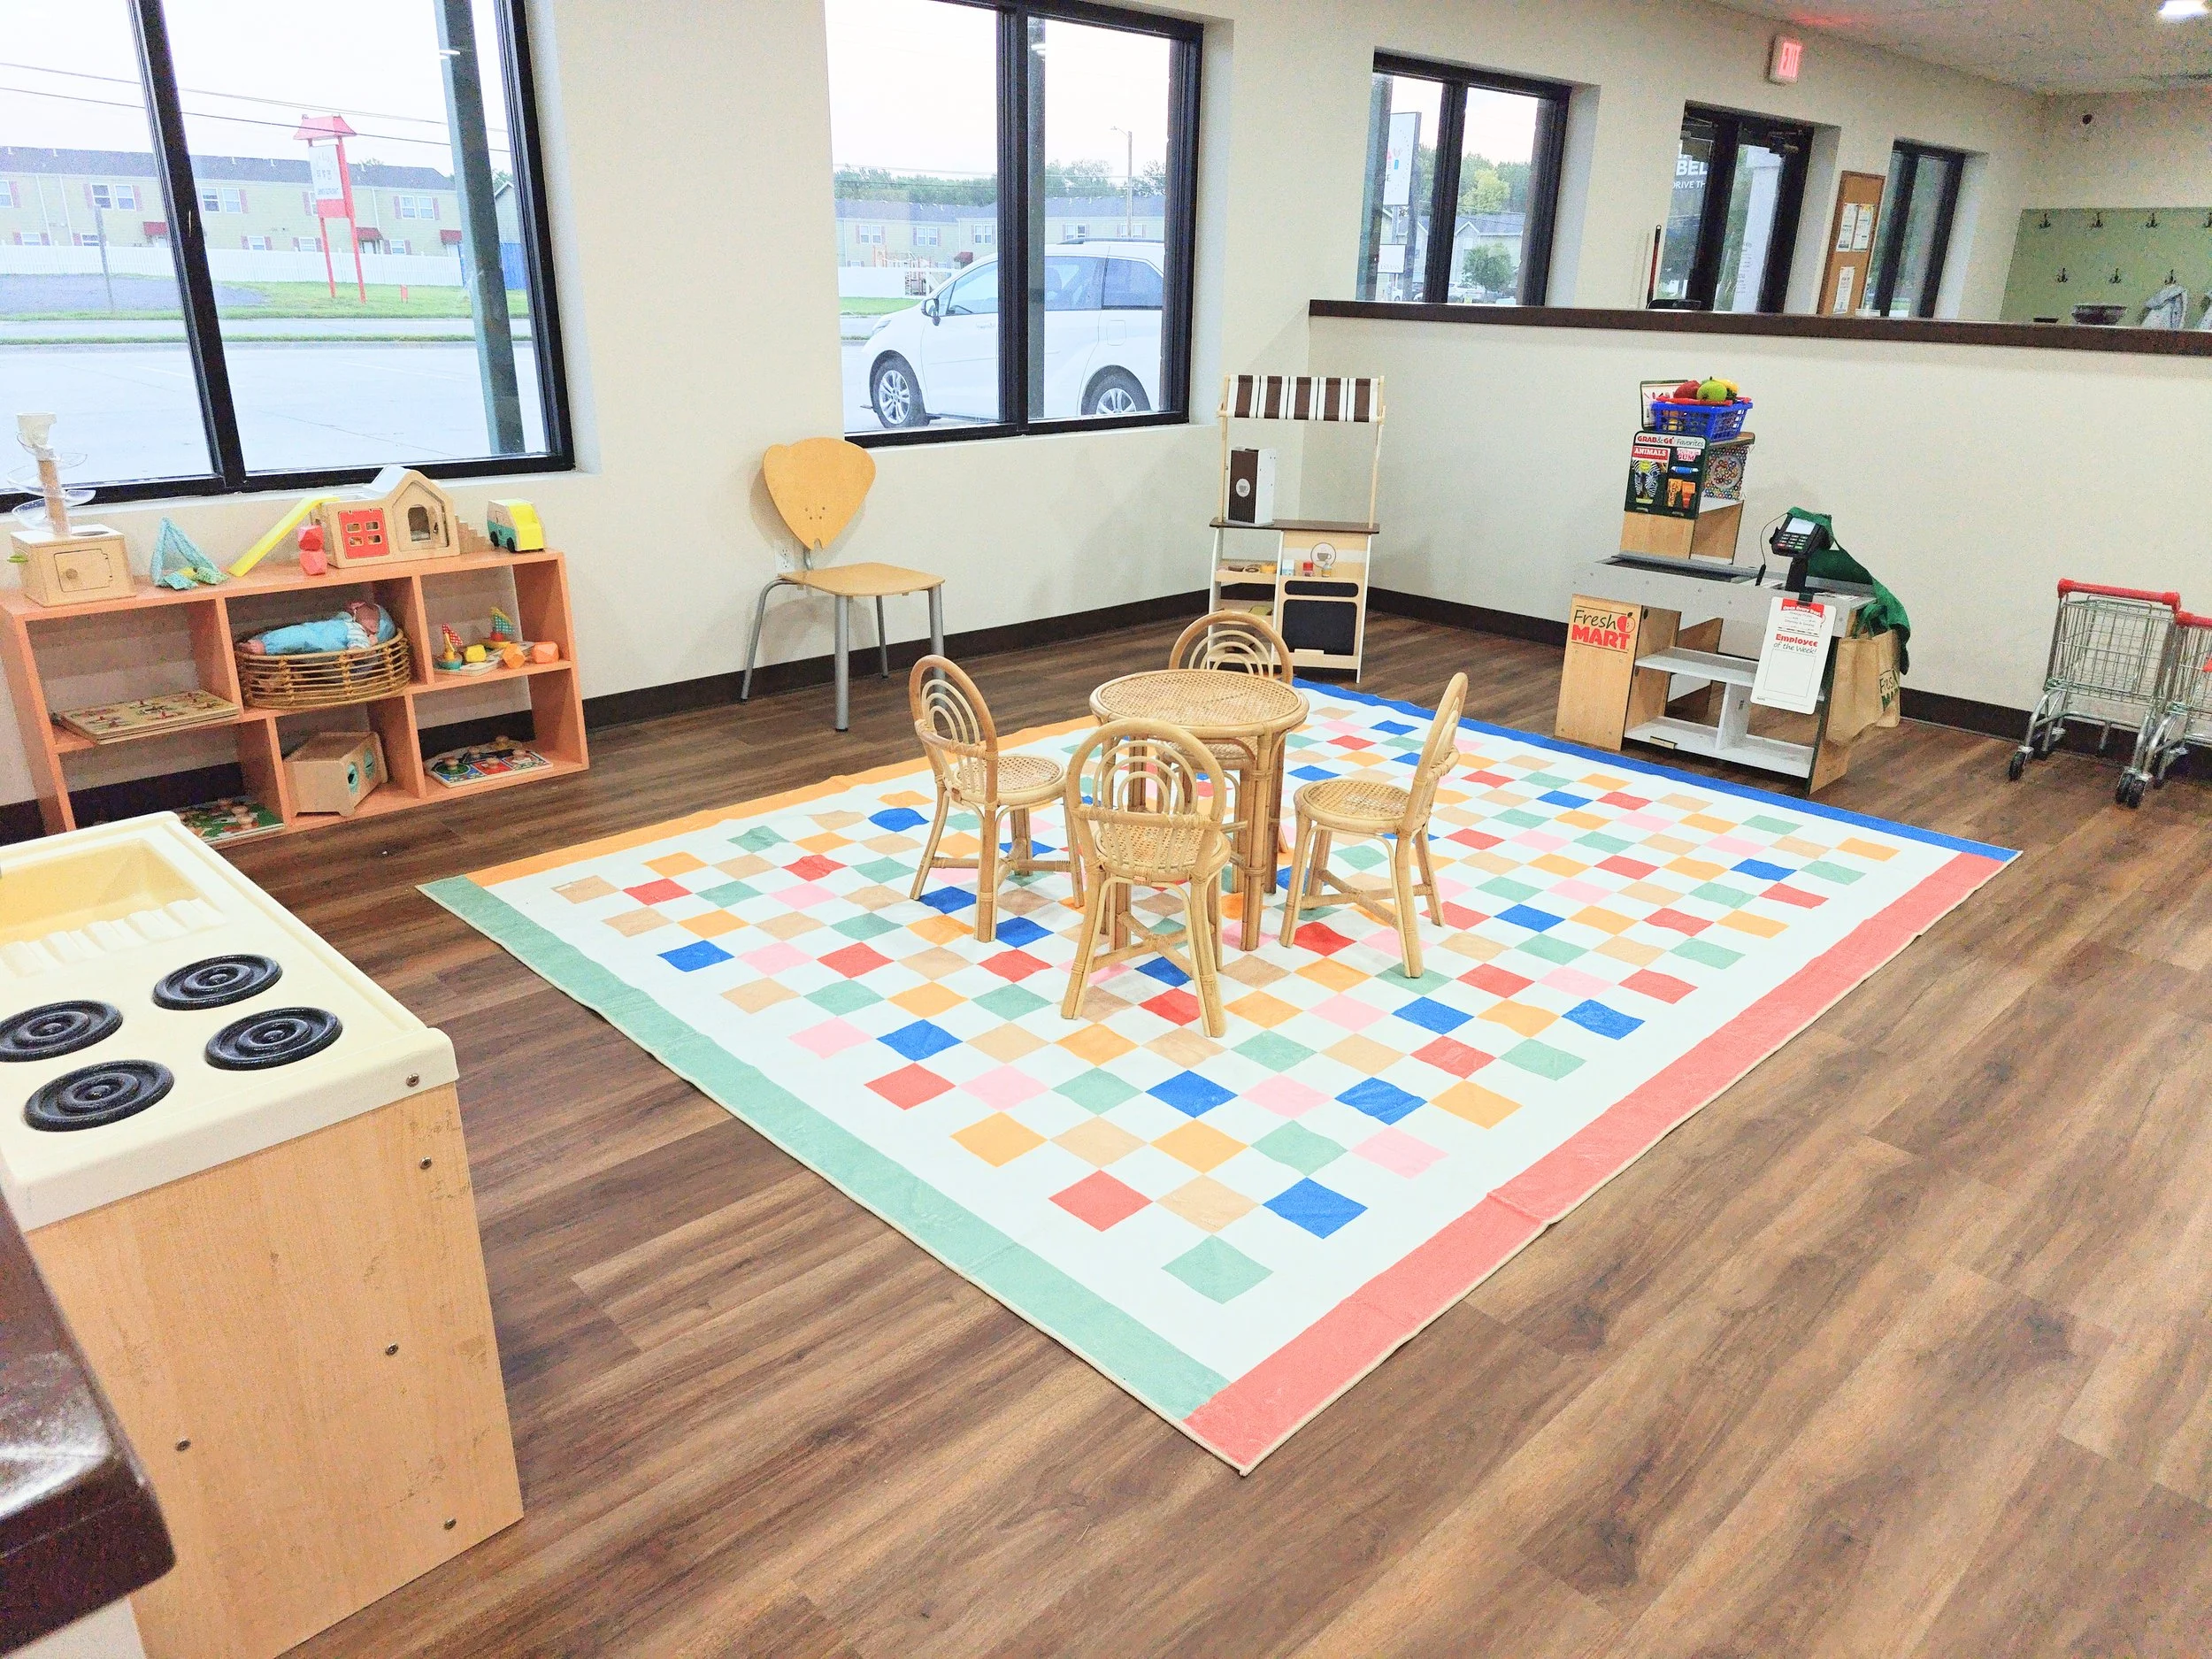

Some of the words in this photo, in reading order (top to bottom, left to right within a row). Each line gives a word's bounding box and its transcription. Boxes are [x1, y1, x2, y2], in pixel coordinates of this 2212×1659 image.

[1778, 42, 1802, 78] EXIT
[1676, 438, 1704, 447] Favorites
[1633, 447, 1667, 457] ANIMALS
[1573, 609, 1617, 630] Fresh
[1571, 624, 1631, 650] MART
[1775, 634, 1818, 647] Employee
[1782, 642, 1794, 651] the
